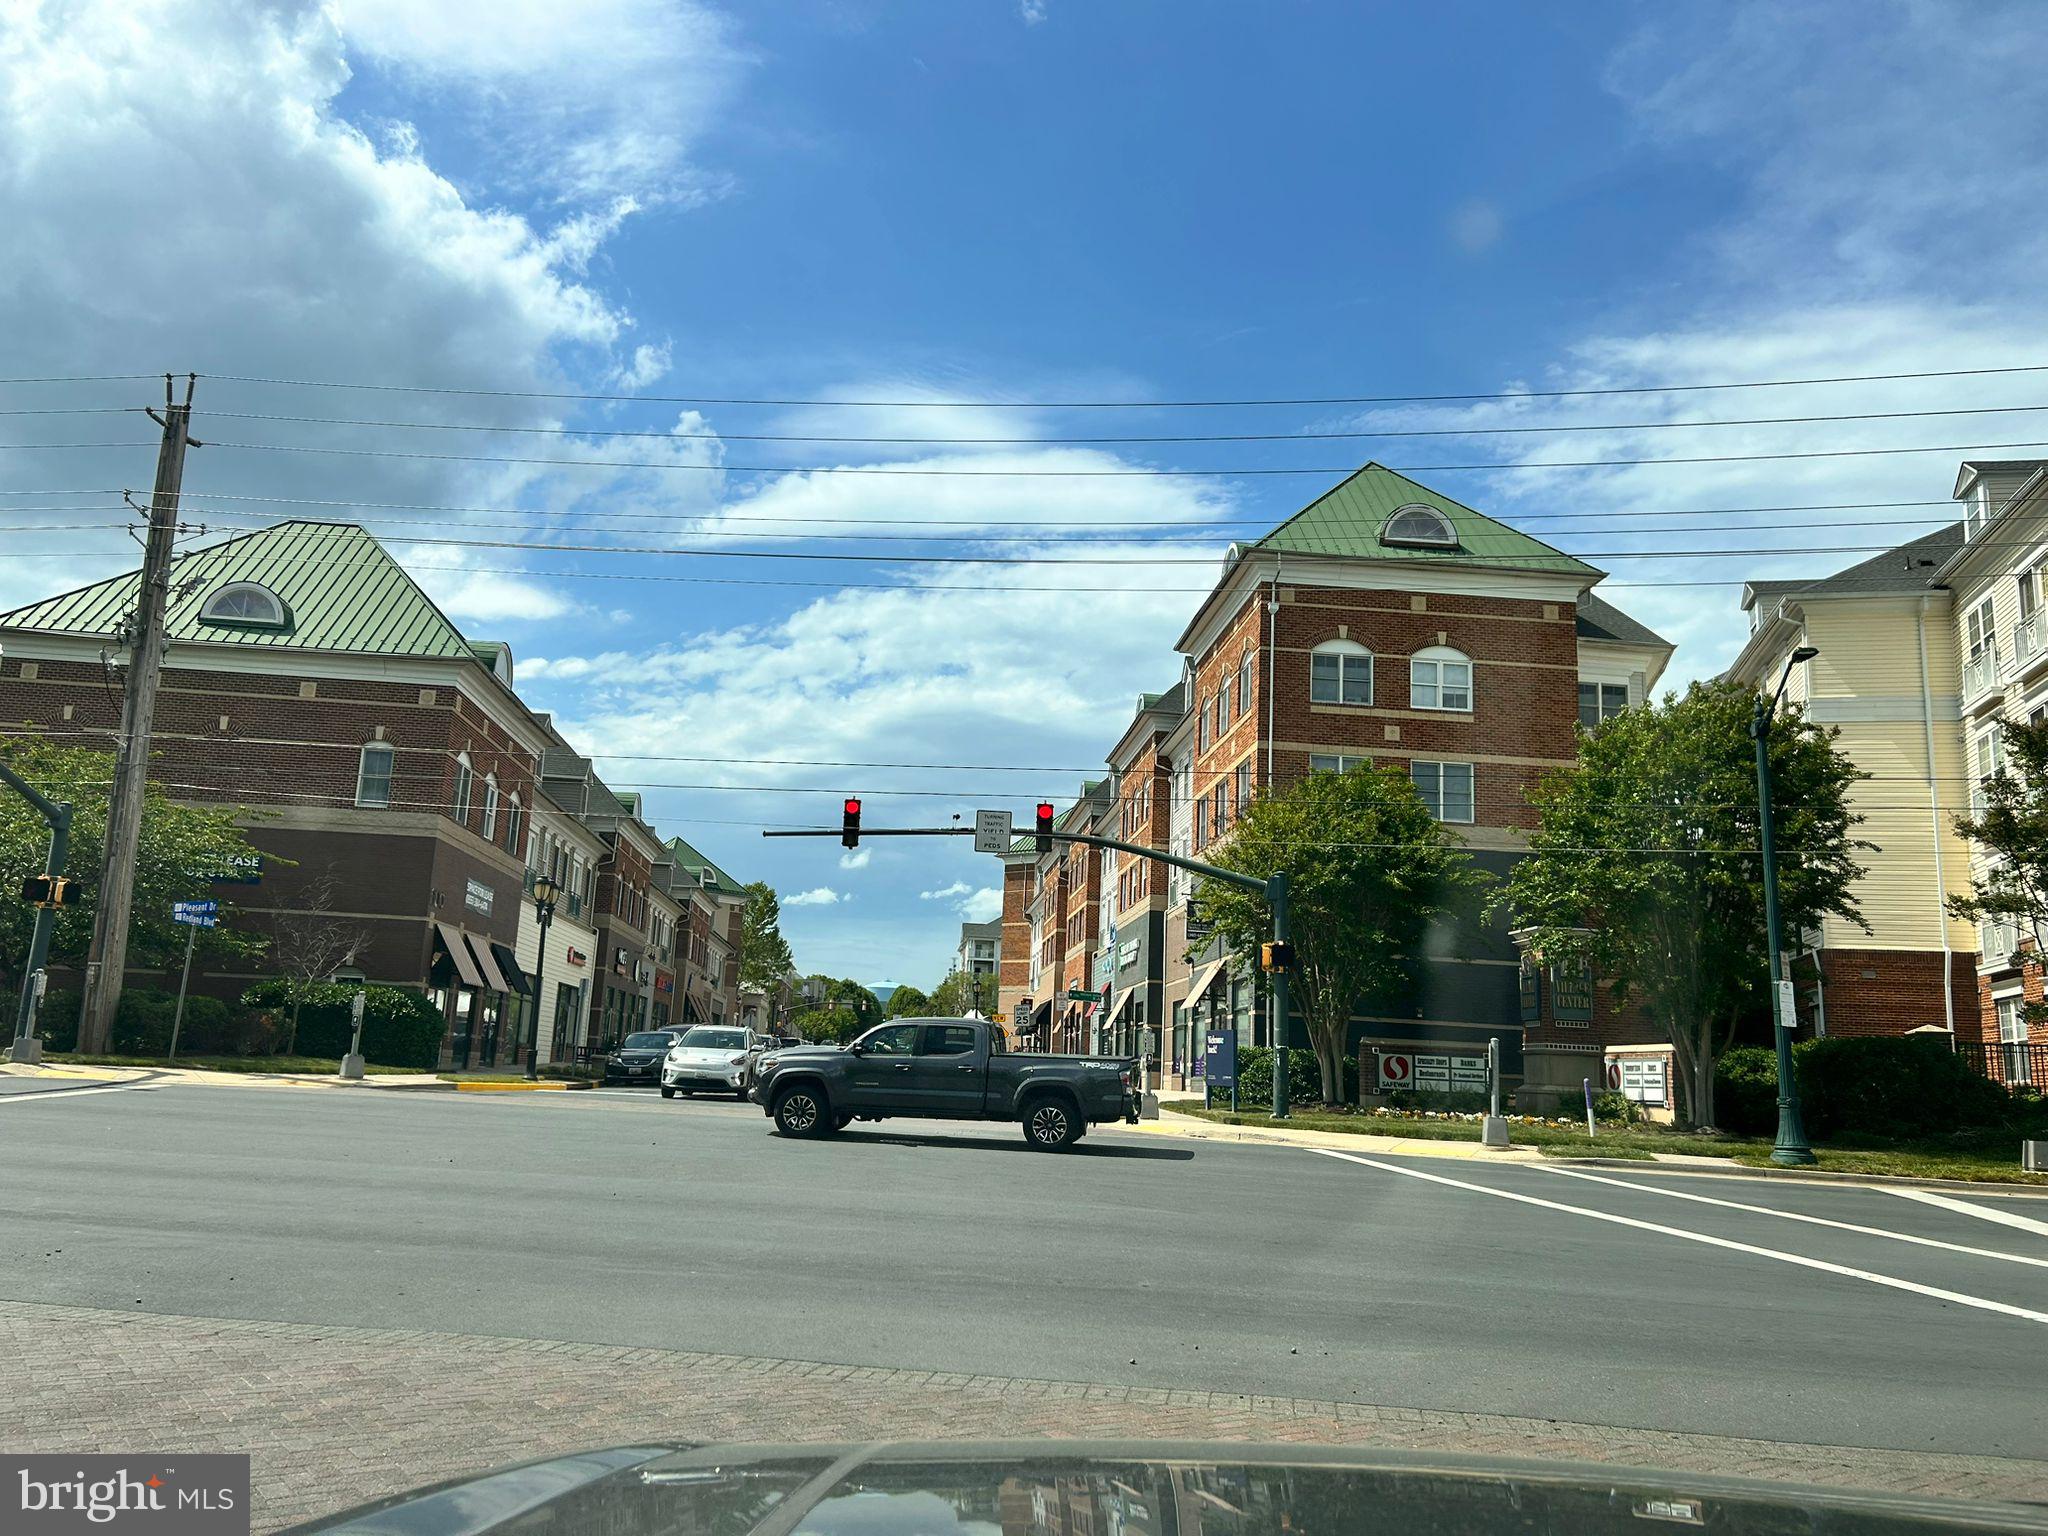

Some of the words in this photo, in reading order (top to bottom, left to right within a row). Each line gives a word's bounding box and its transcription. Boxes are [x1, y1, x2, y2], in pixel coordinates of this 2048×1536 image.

[220, 855, 260, 867] EASE
[182, 903, 208, 912] Pleasant
[209, 902, 217, 911] Dr
[182, 912, 202, 925] Redland
[203, 916, 215, 927] Blvd
[1557, 994, 1590, 1009] CENTER
[1015, 1016, 1029, 1025] 25
[1460, 1059, 1477, 1067] BANKS
